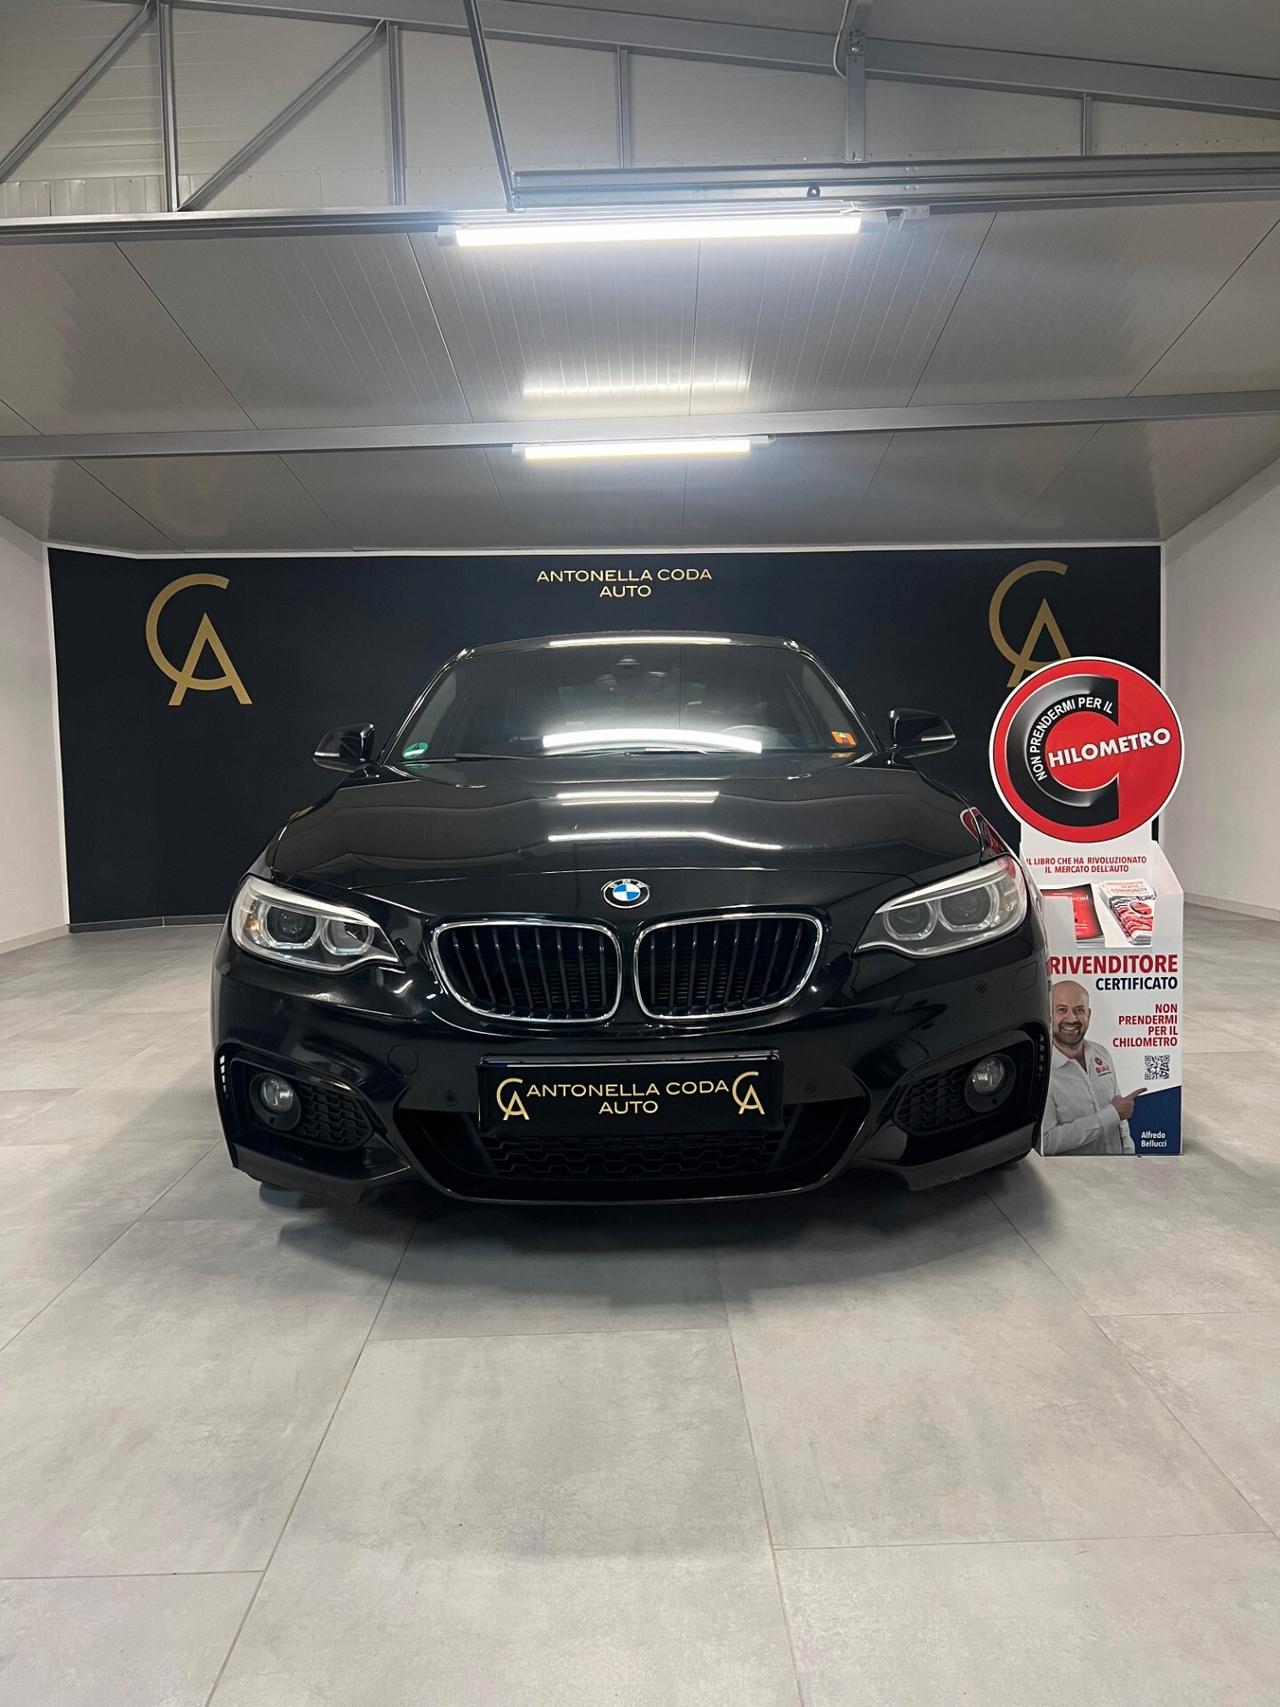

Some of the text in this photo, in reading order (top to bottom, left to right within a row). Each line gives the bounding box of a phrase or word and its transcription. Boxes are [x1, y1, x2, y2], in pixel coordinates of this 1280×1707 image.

[536, 568, 712, 582] ANTONELLA CODA
[599, 585, 652, 598] AUTO
[1029, 697, 1114, 781] NON PRENDERMI PER IL
[1034, 857, 1056, 865] LIBRO
[1057, 857, 1072, 865] CHE
[1073, 857, 1084, 865] HA
[1087, 856, 1147, 864] RIVOLUZIONATO
[1054, 865, 1090, 873] MERCATO
[1091, 864, 1130, 873] DELL'AUTO
[1049, 954, 1178, 975] RIVENDITORE
[1095, 976, 1178, 991] CERTIFICATO
[1155, 1003, 1178, 1014] NON
[1118, 1014, 1178, 1025] PRENDERMI
[1148, 1026, 1178, 1036] PER IL
[1112, 1037, 1178, 1047] CHILOMETRO
[526, 1080, 729, 1097] ANTONELLA CODA
[598, 1100, 659, 1115] AUTO
[1141, 1131, 1166, 1139] Alfredo
[1141, 1140, 1167, 1148] Bellucci
